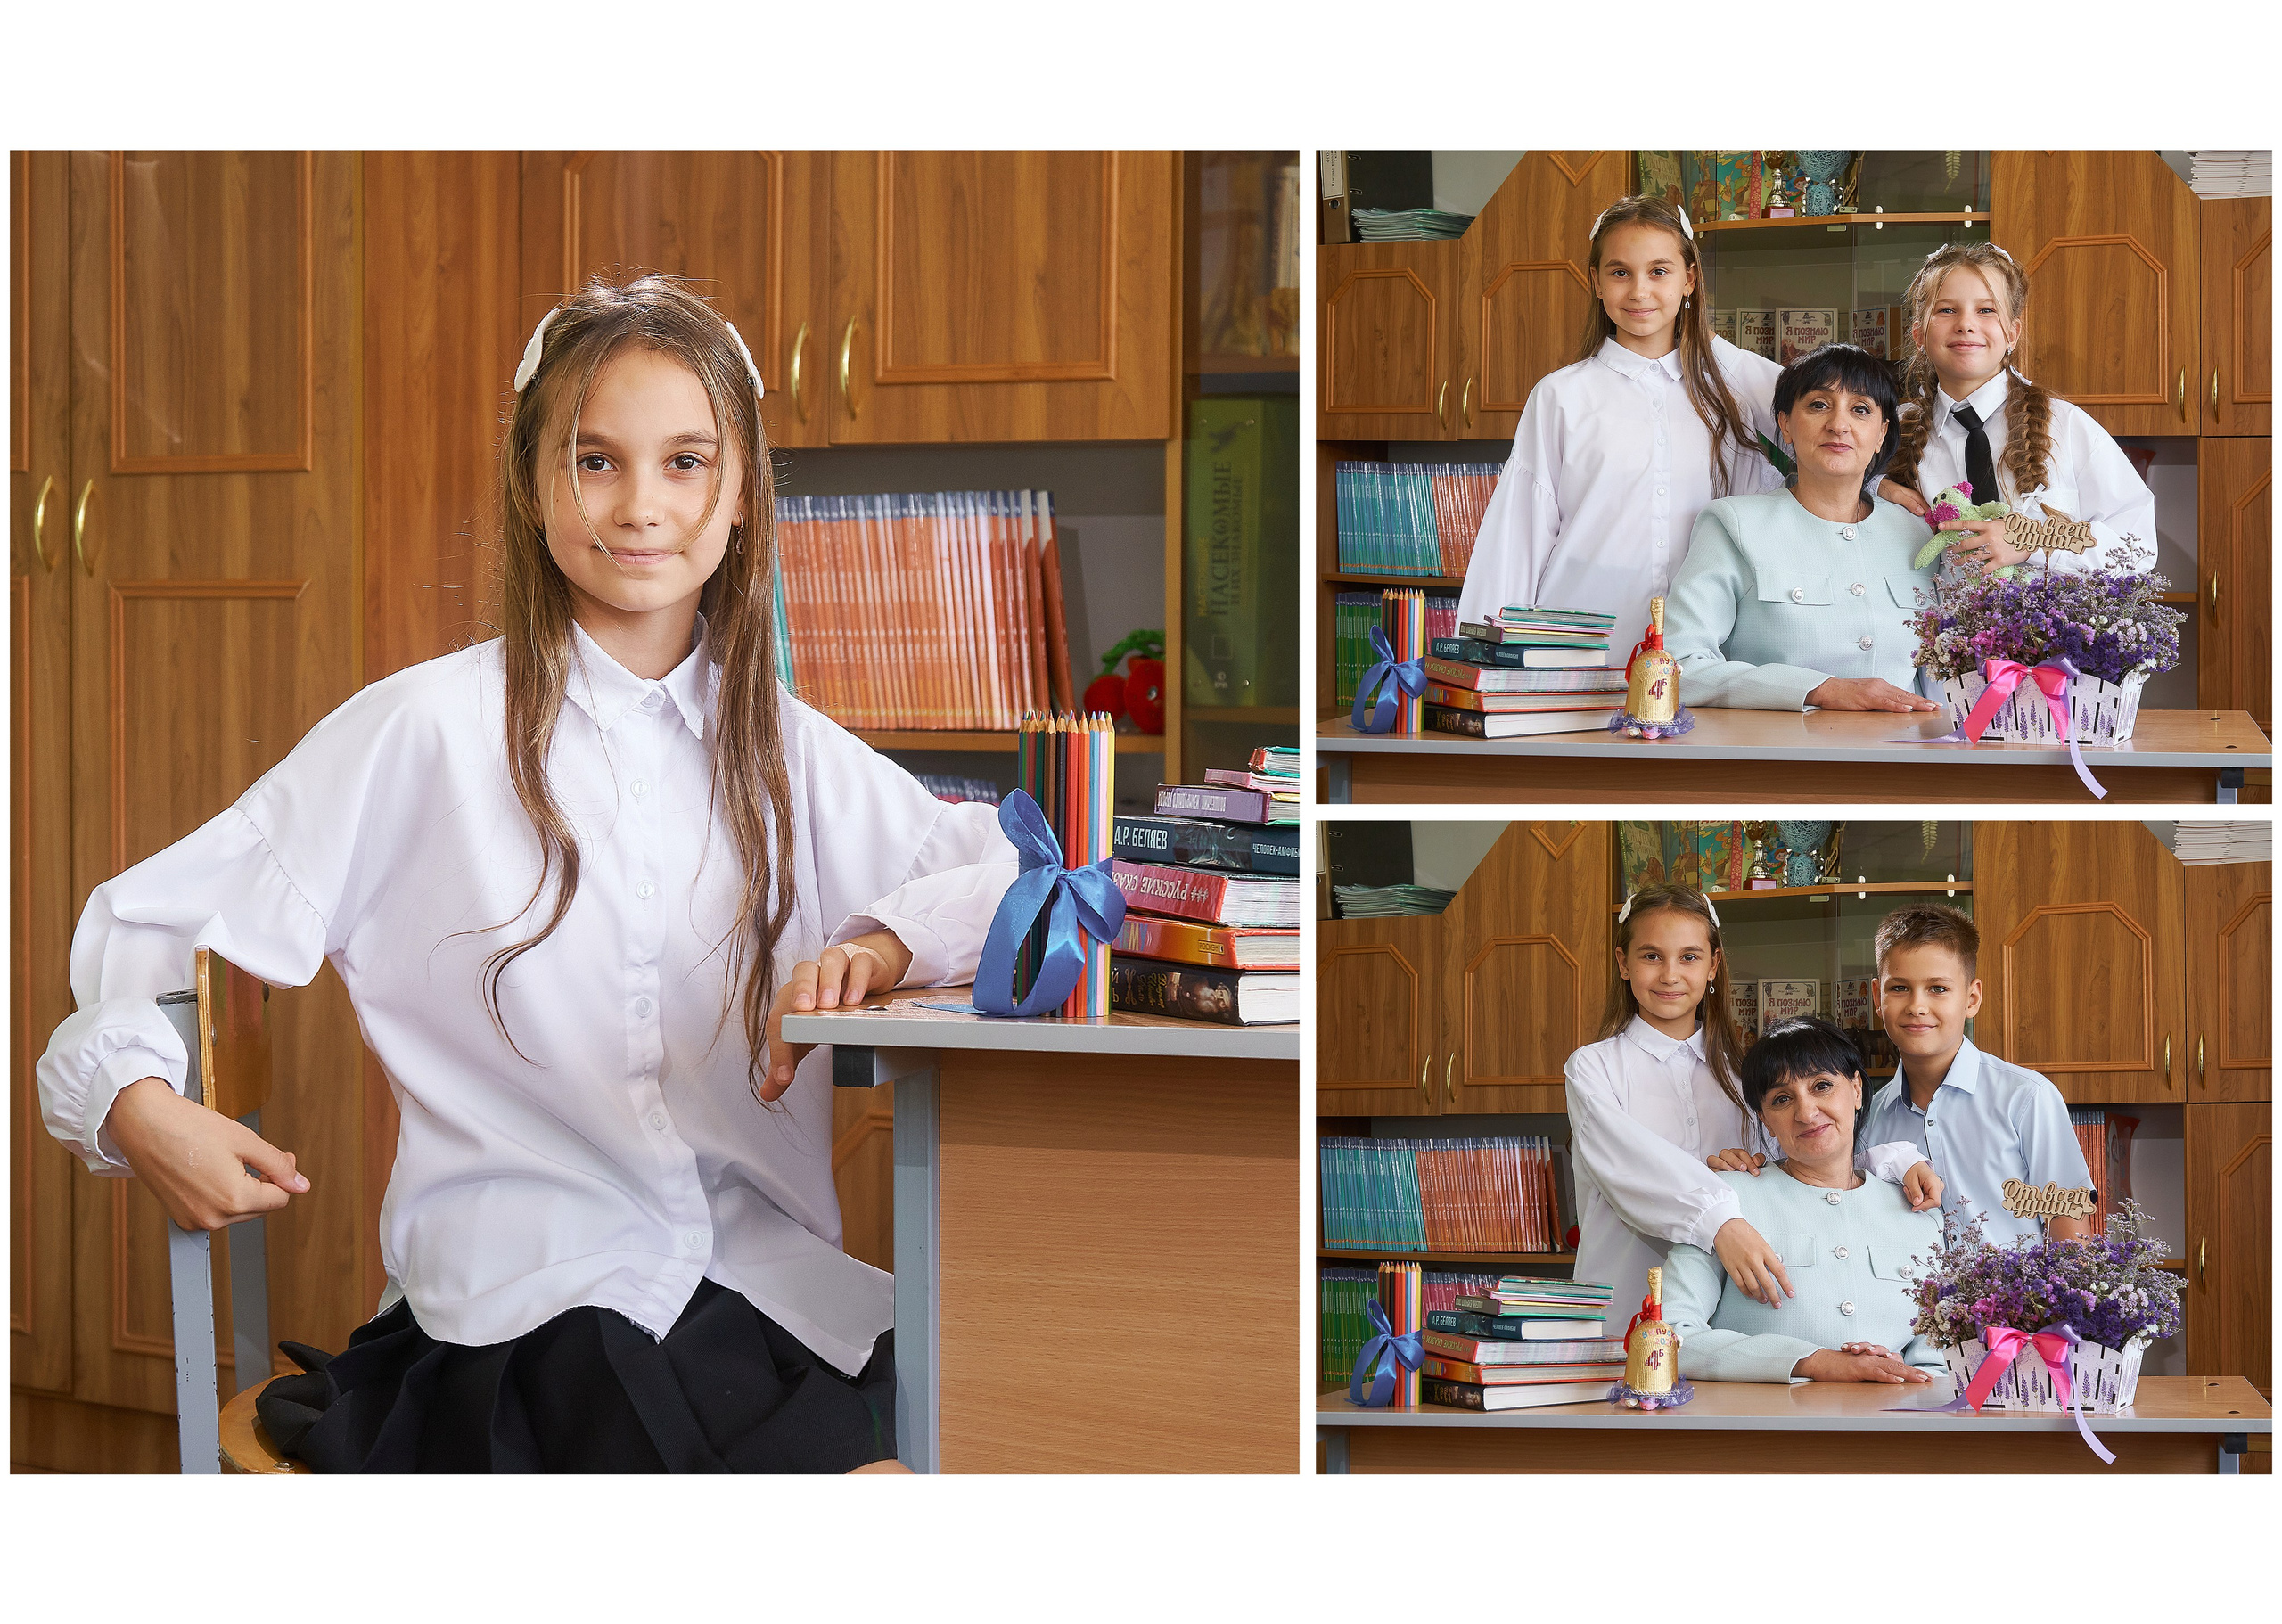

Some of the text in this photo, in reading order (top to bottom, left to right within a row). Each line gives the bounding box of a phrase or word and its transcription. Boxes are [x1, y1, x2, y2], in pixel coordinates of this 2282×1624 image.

[1753, 326, 1775, 336] ПОЗН
[1785, 326, 1829, 336] Я ПОЗНАЮ
[1859, 326, 1884, 338] ПОЗНАЮ
[1755, 336, 1774, 345] МИР
[1797, 335, 1815, 345] МИР
[1861, 337, 1876, 347] МИР
[2003, 513, 2089, 539] От всей
[1211, 461, 1232, 616] НАСЕКОМЫЕ
[2015, 532, 2071, 551] души
[1131, 826, 1169, 850] БЕЛЯЕВ
[1112, 871, 1189, 901] РУССКИЕ СКАЗ
[1736, 998, 1757, 1007] ПОЗН
[1768, 997, 1812, 1007] Я ПОЗНАЮ
[1841, 997, 1867, 1009] ПОЗНАЮ
[1738, 1007, 1757, 1016] МИР
[1843, 1006, 1859, 1018] МИР
[2001, 1179, 2089, 1204] От всей
[2013, 1198, 2070, 1218] души
